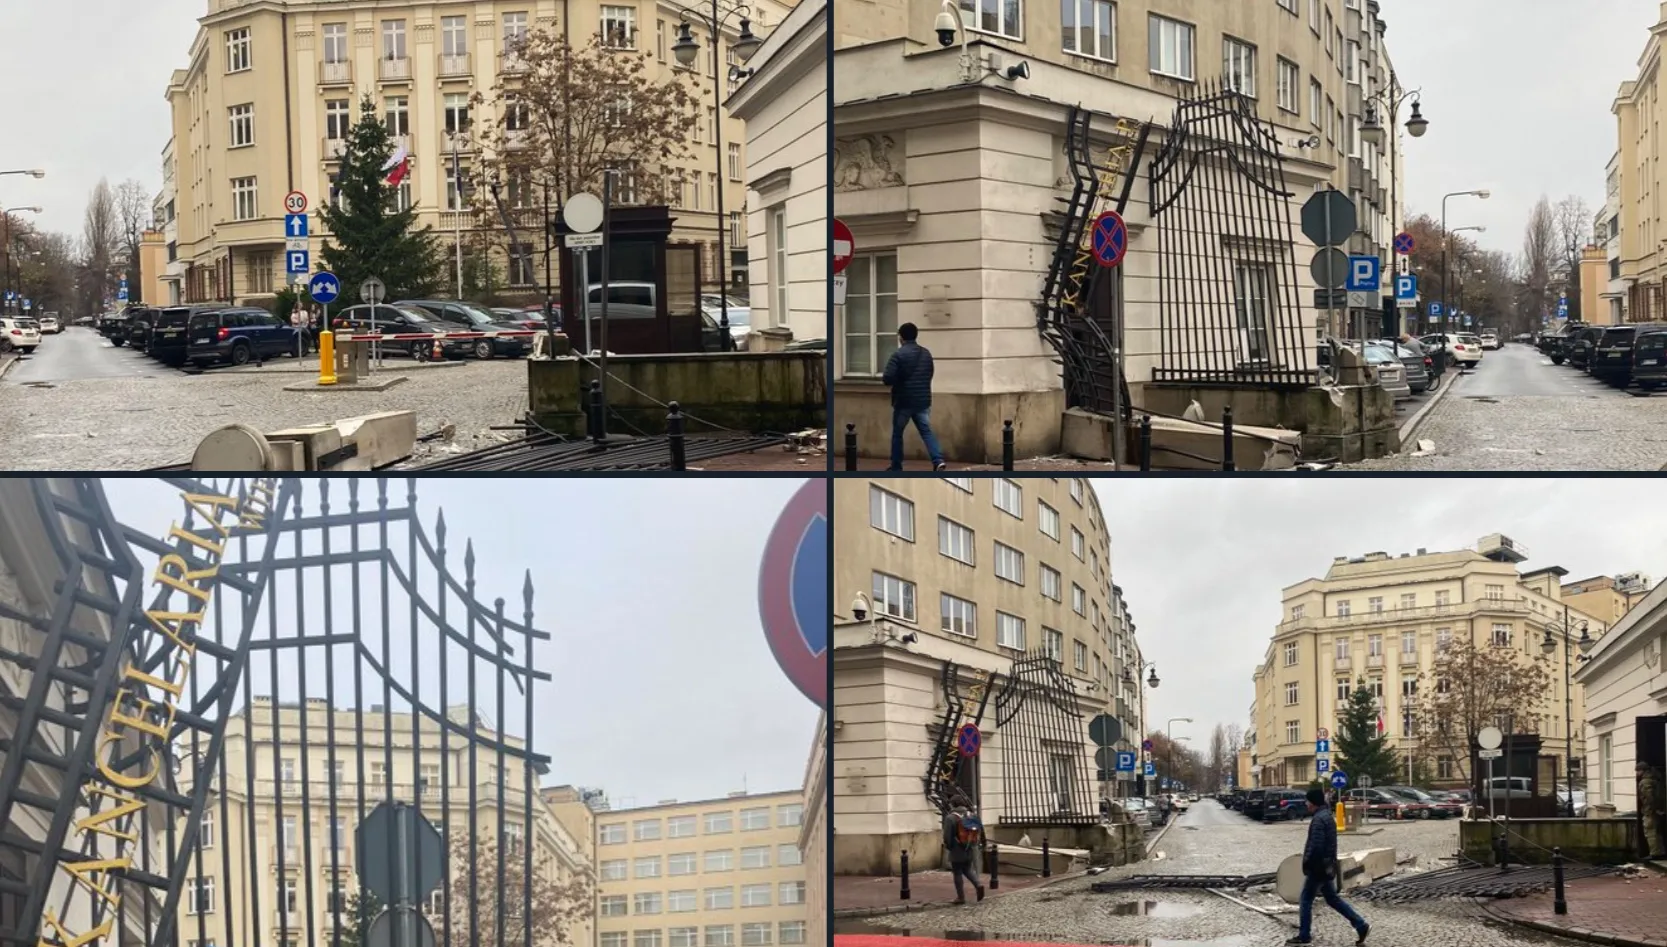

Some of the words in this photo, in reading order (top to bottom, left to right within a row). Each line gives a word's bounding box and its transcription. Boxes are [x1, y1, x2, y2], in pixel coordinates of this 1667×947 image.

[288, 196, 304, 208] 30
[291, 253, 305, 271] P
[1353, 260, 1373, 286] P
[1398, 278, 1411, 296] P
[1431, 303, 1440, 315] P
[37, 493, 240, 947] KANCELARIA
[1119, 754, 1131, 769] P
[1145, 764, 1153, 774] P
[1319, 760, 1328, 771] P
